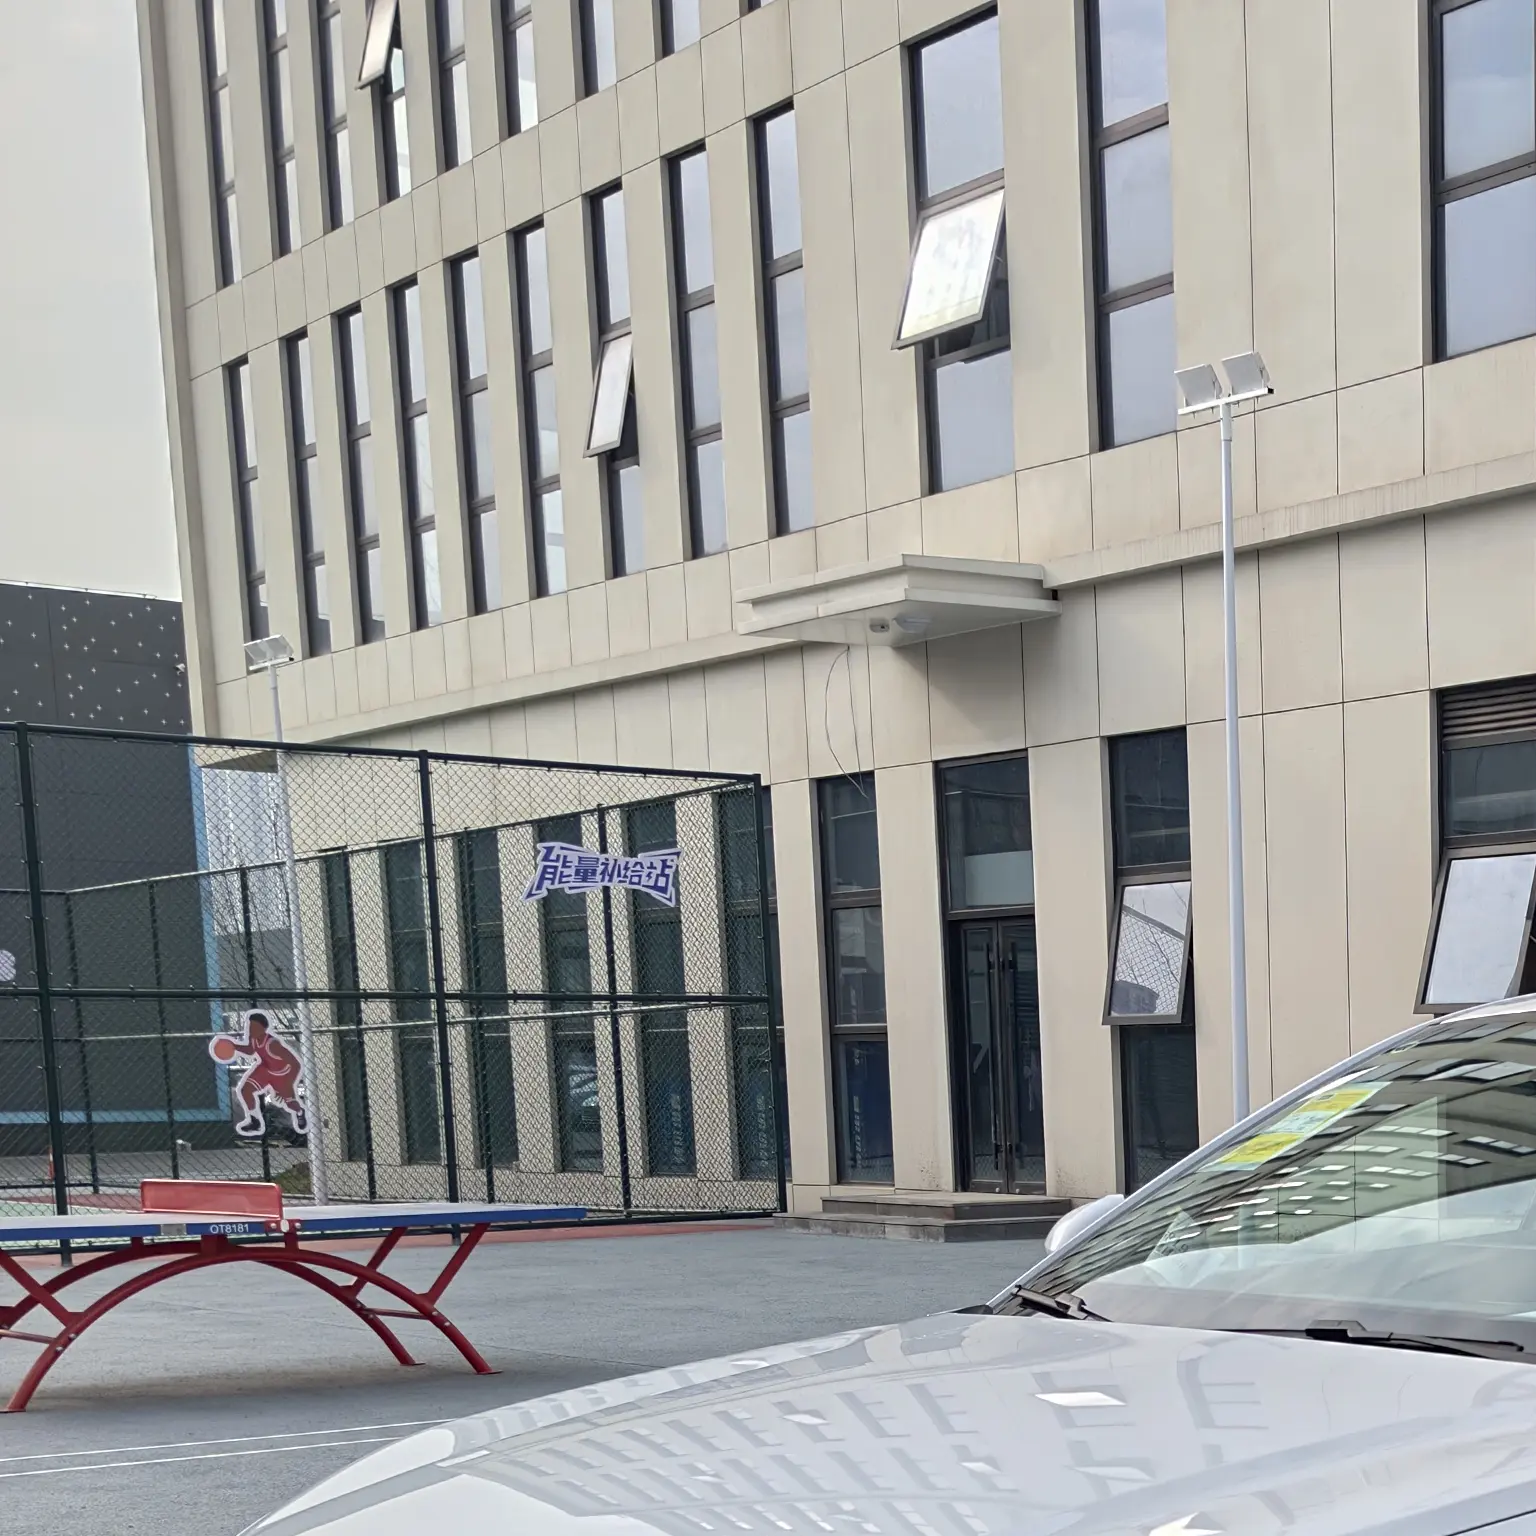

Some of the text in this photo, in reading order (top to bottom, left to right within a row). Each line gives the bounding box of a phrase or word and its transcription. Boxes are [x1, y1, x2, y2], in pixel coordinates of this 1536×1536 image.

[534, 845, 676, 897] 能量补给站
[210, 1223, 249, 1234] OT8181
